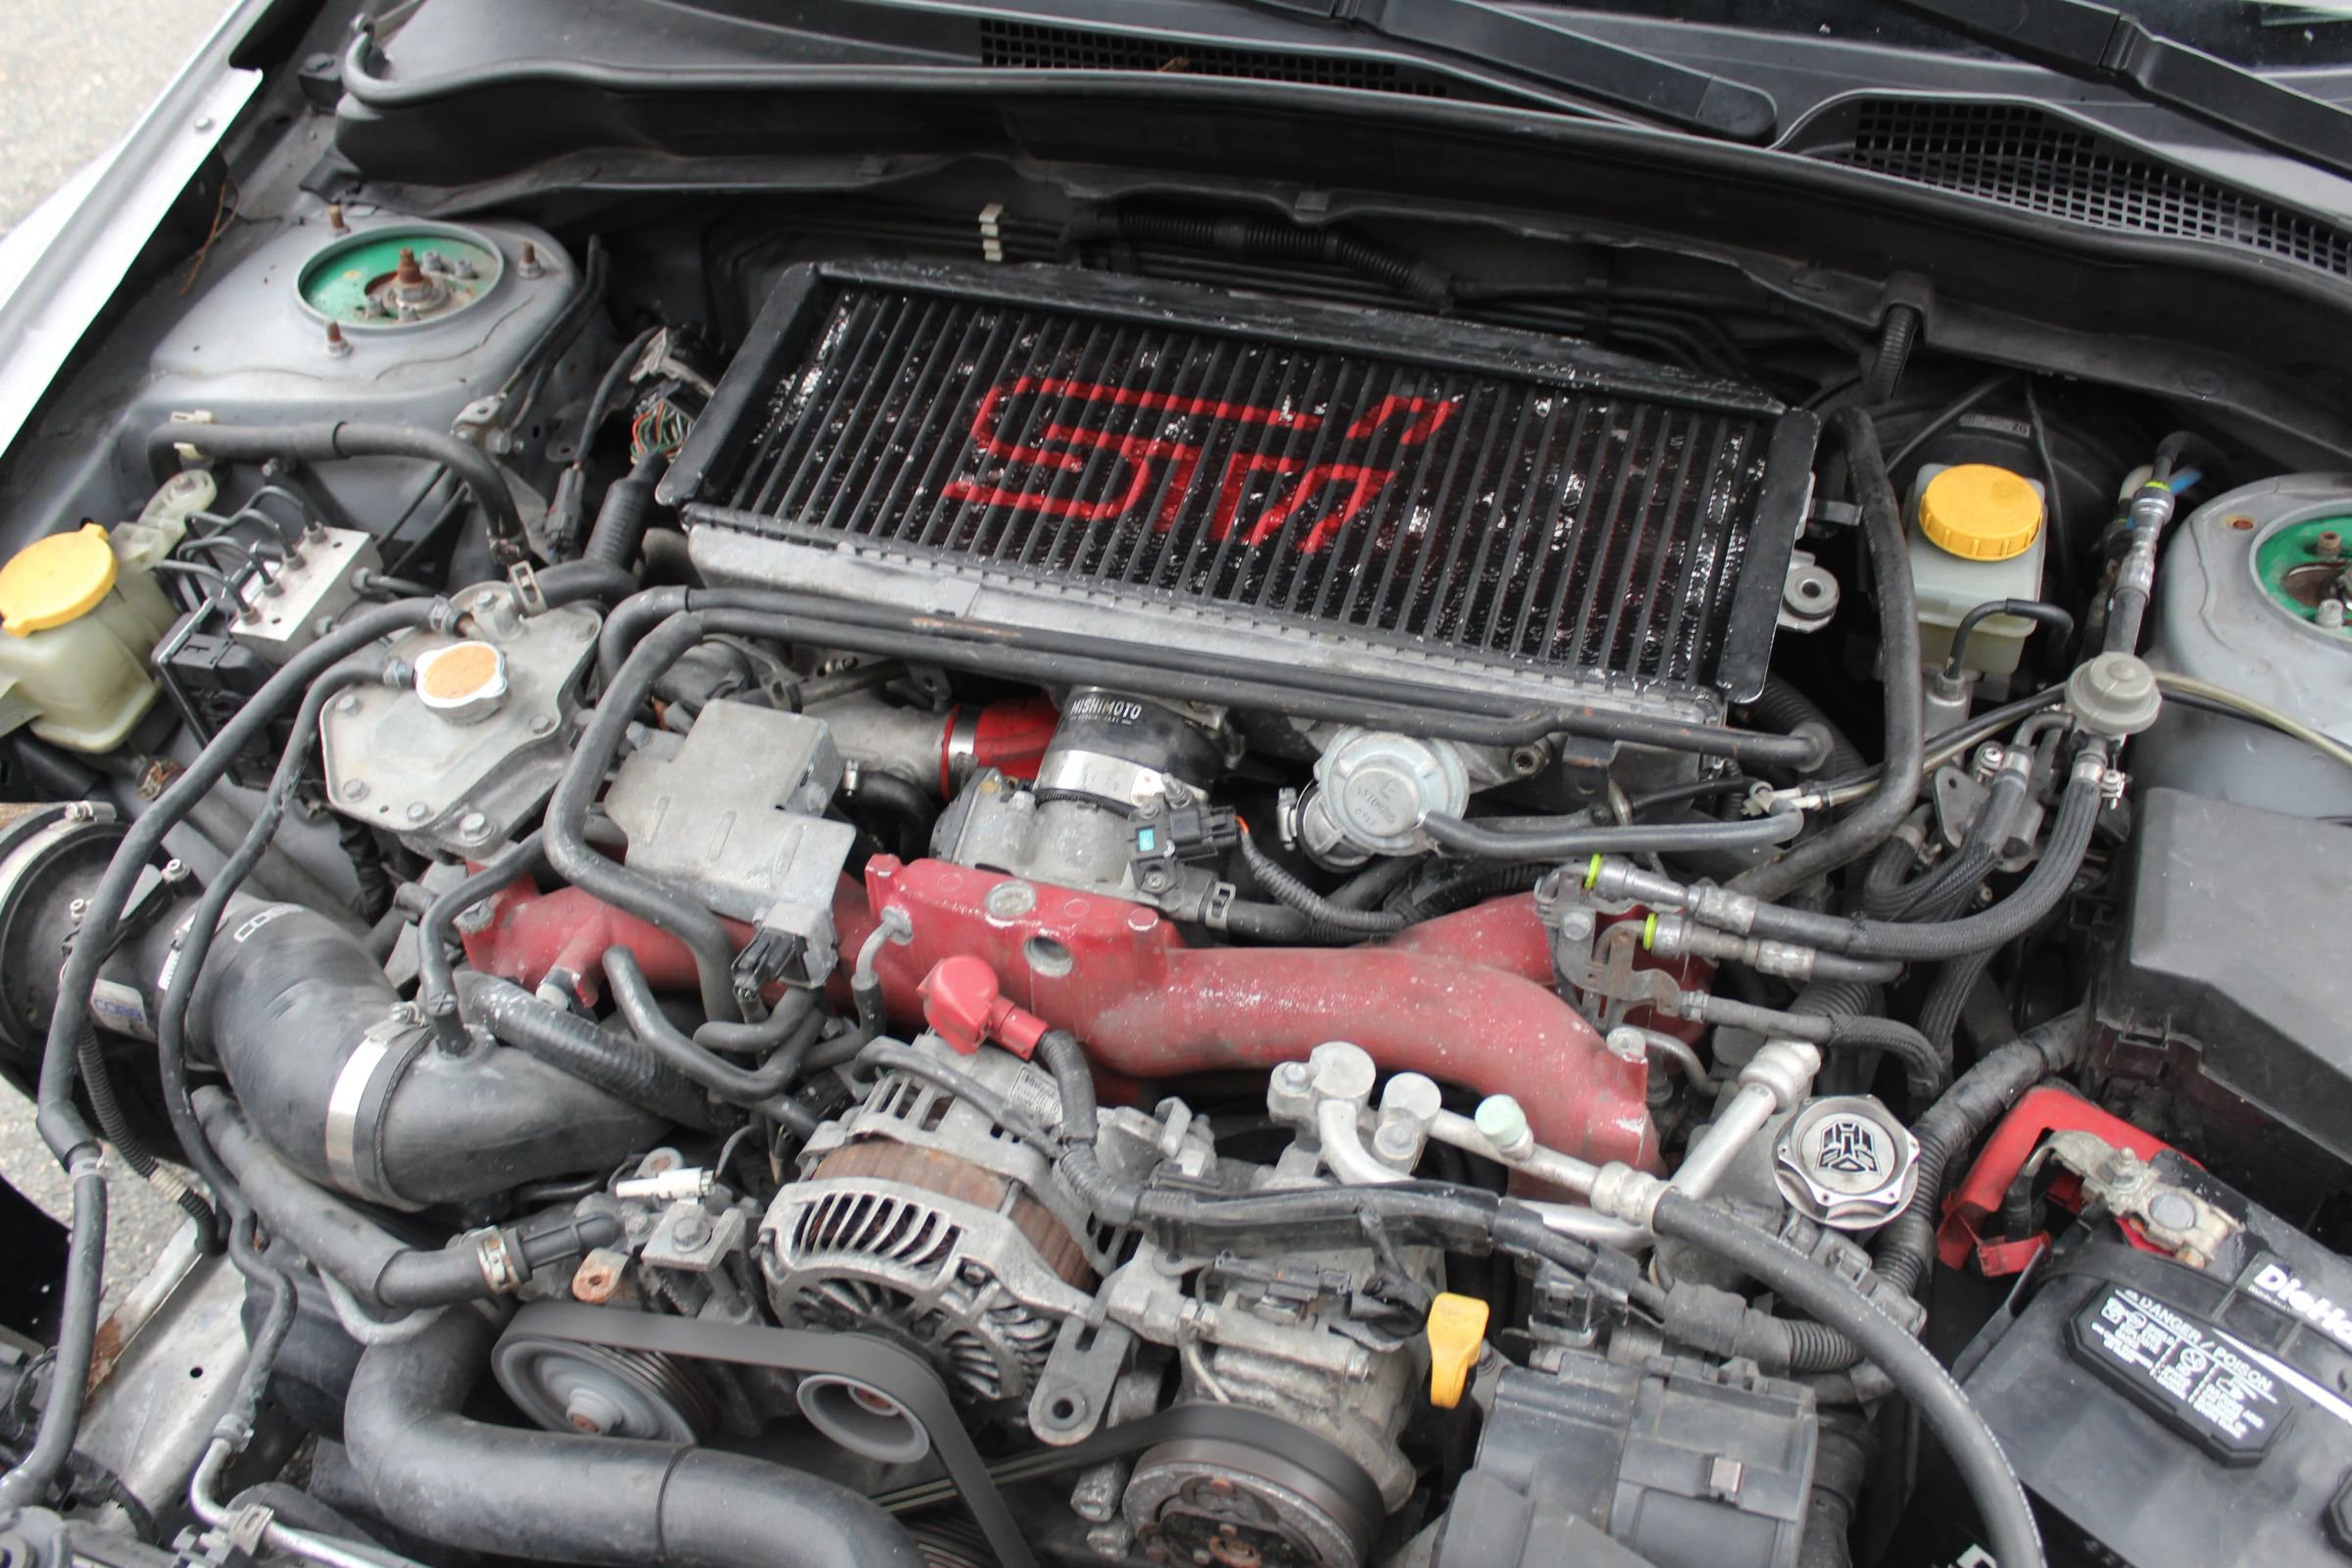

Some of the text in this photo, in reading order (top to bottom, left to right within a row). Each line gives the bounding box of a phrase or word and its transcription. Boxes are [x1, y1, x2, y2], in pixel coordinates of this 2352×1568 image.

[1070, 697, 1143, 720] MISHIMOTO
[2138, 1296, 2203, 1345] DANGER
[2212, 1346, 2275, 1392] POISON
